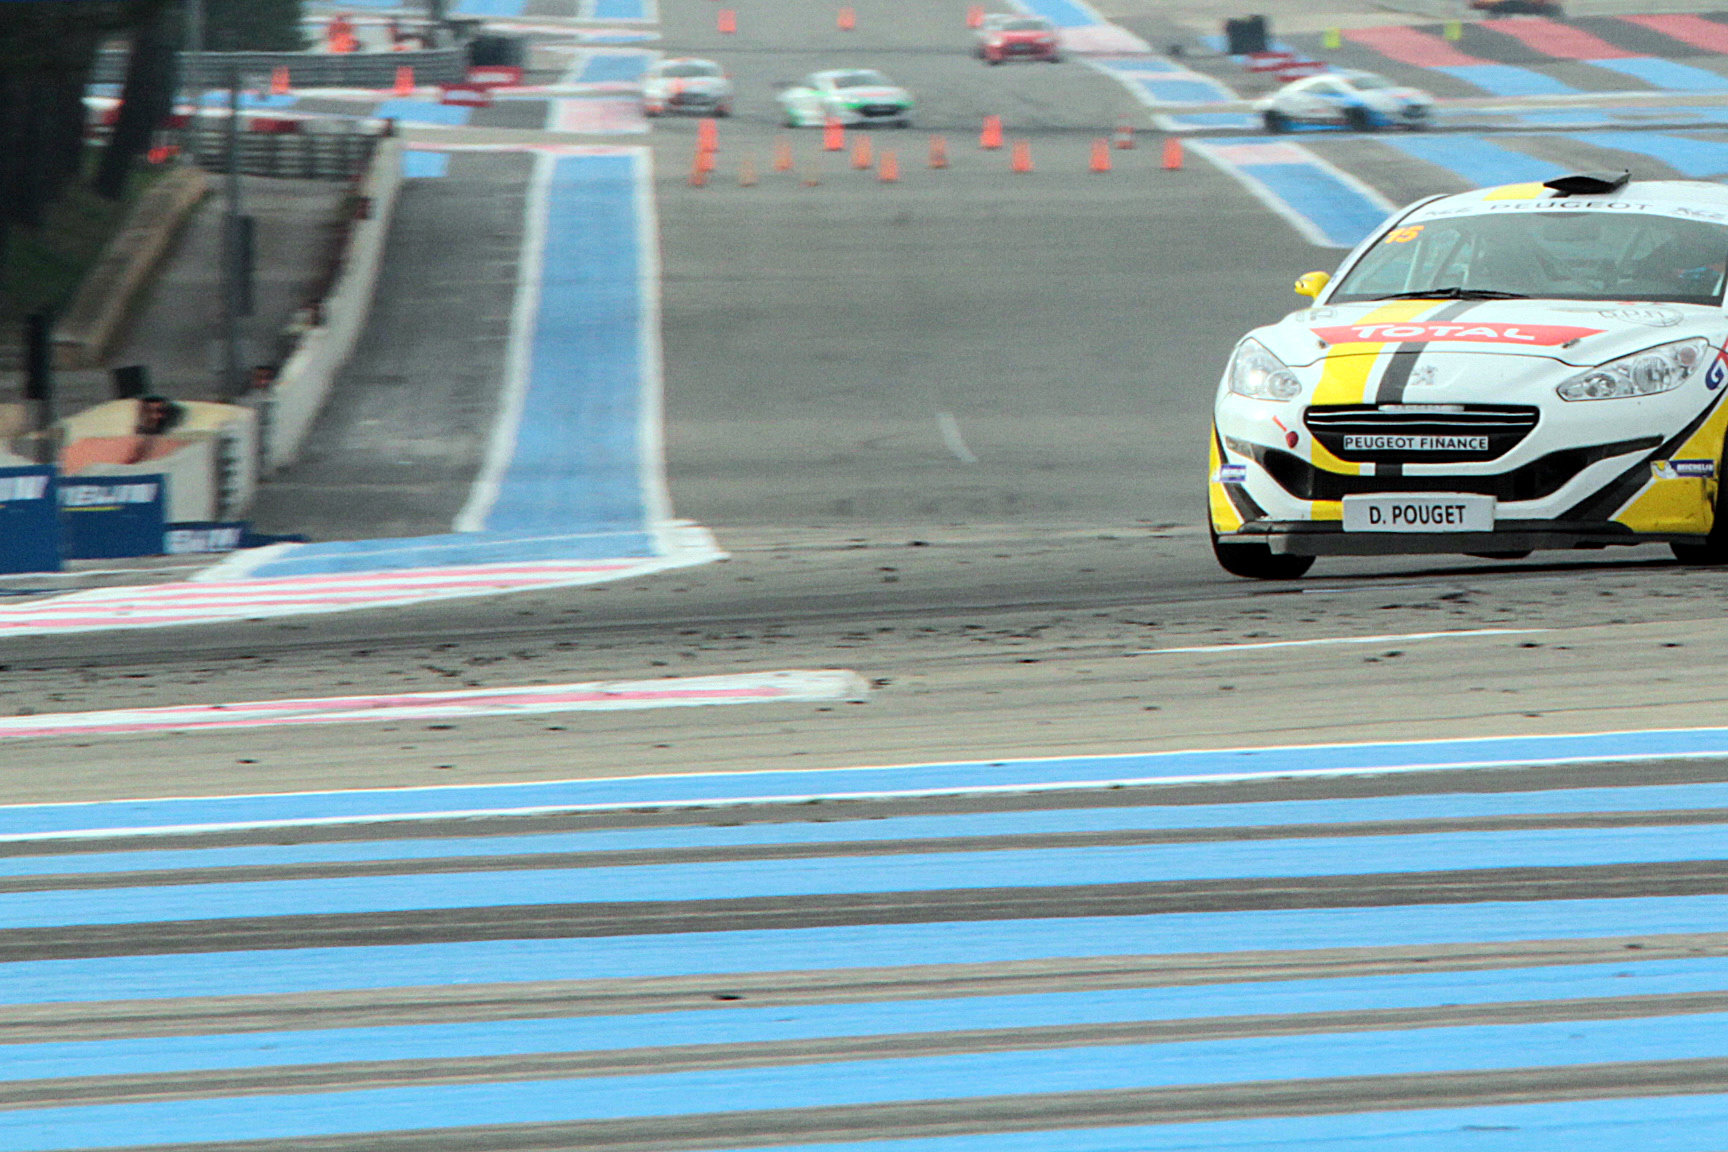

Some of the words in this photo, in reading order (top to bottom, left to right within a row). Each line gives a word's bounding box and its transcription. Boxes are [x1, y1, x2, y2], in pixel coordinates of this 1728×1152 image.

[1385, 225, 1425, 244] 15
[1350, 323, 1536, 342] TOTAL
[1344, 436, 1415, 450] PEUGEOT
[1420, 436, 1487, 450] FINANCE
[1369, 506, 1387, 525] D.
[1391, 504, 1466, 525] POUGET
